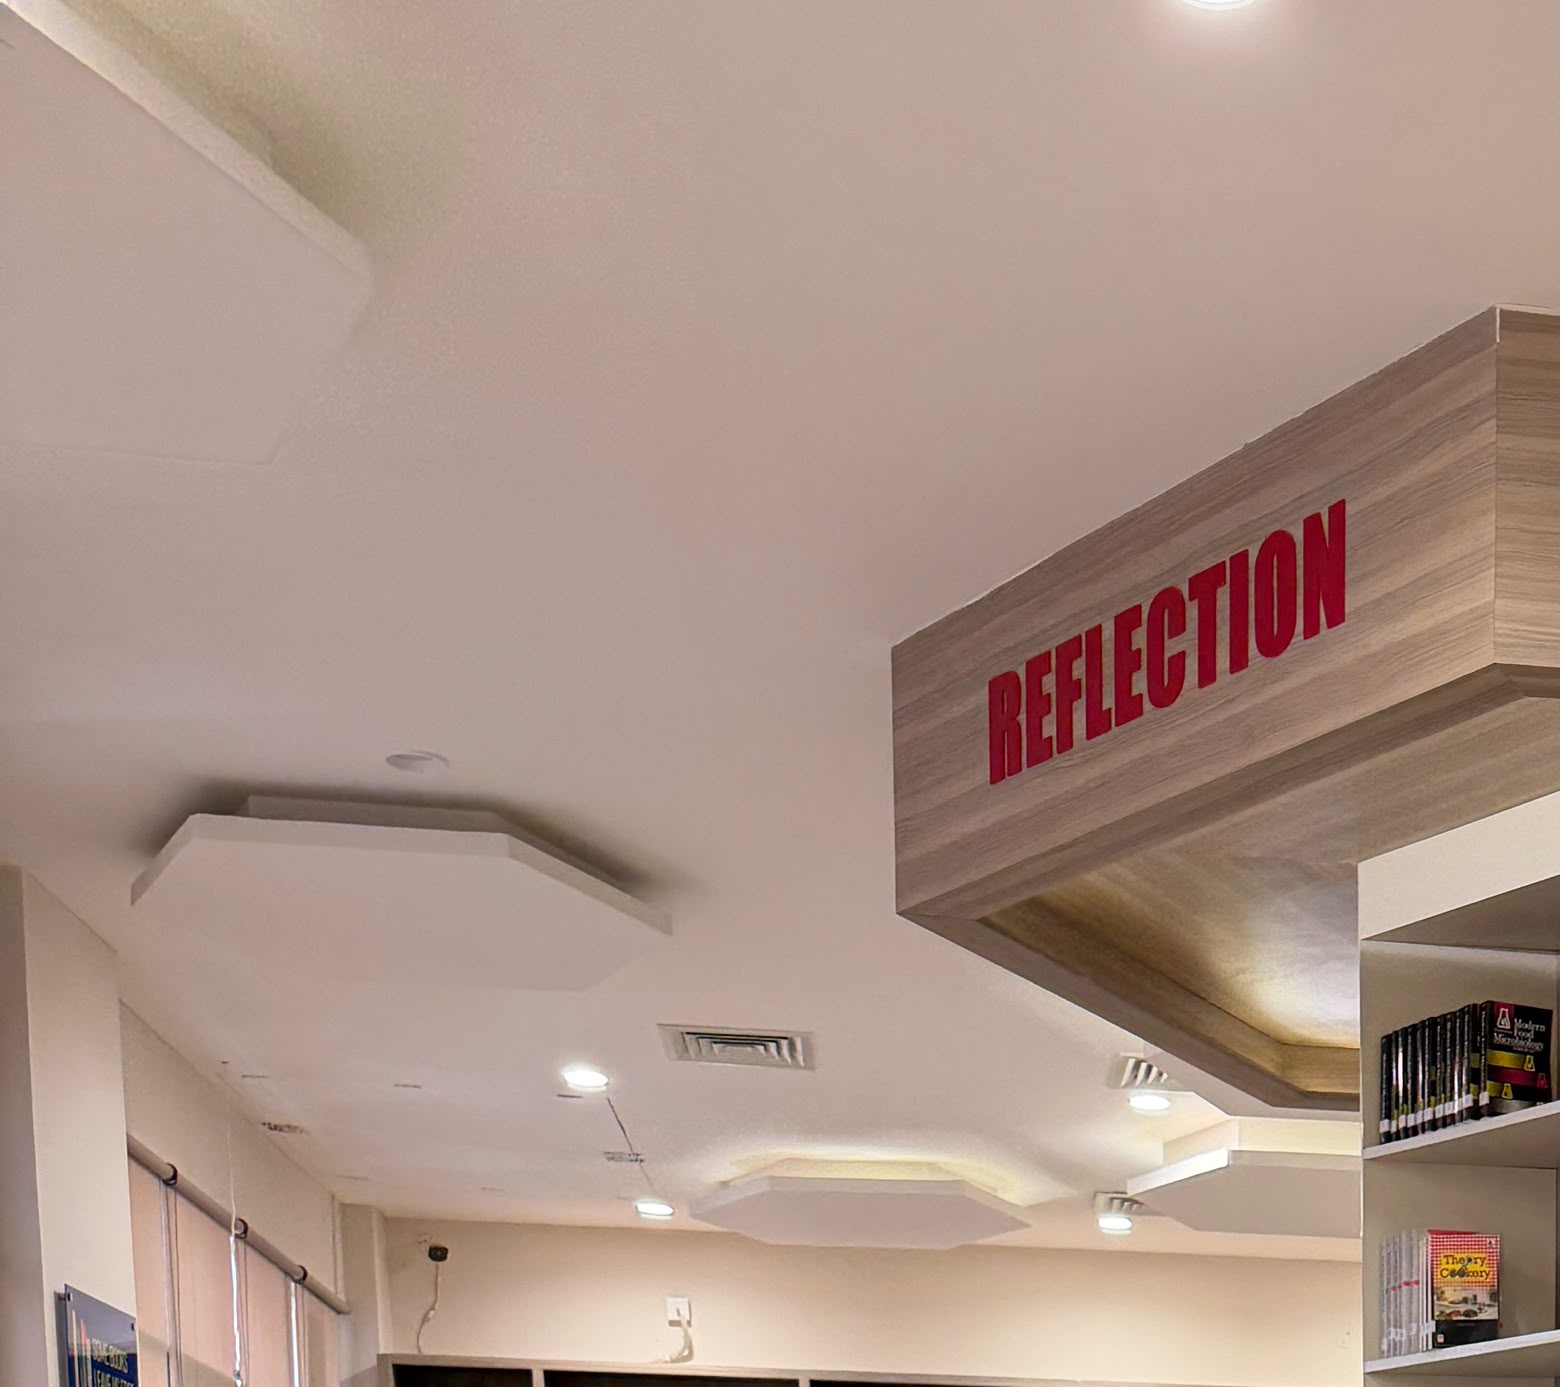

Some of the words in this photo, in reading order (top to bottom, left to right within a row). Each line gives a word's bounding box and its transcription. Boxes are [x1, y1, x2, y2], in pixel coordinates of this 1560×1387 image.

[990, 500, 1346, 784] REFLECTION
[1443, 1254, 1487, 1266] Theory
[91, 1337, 109, 1366] SOME
[108, 1345, 129, 1374] BOOKS
